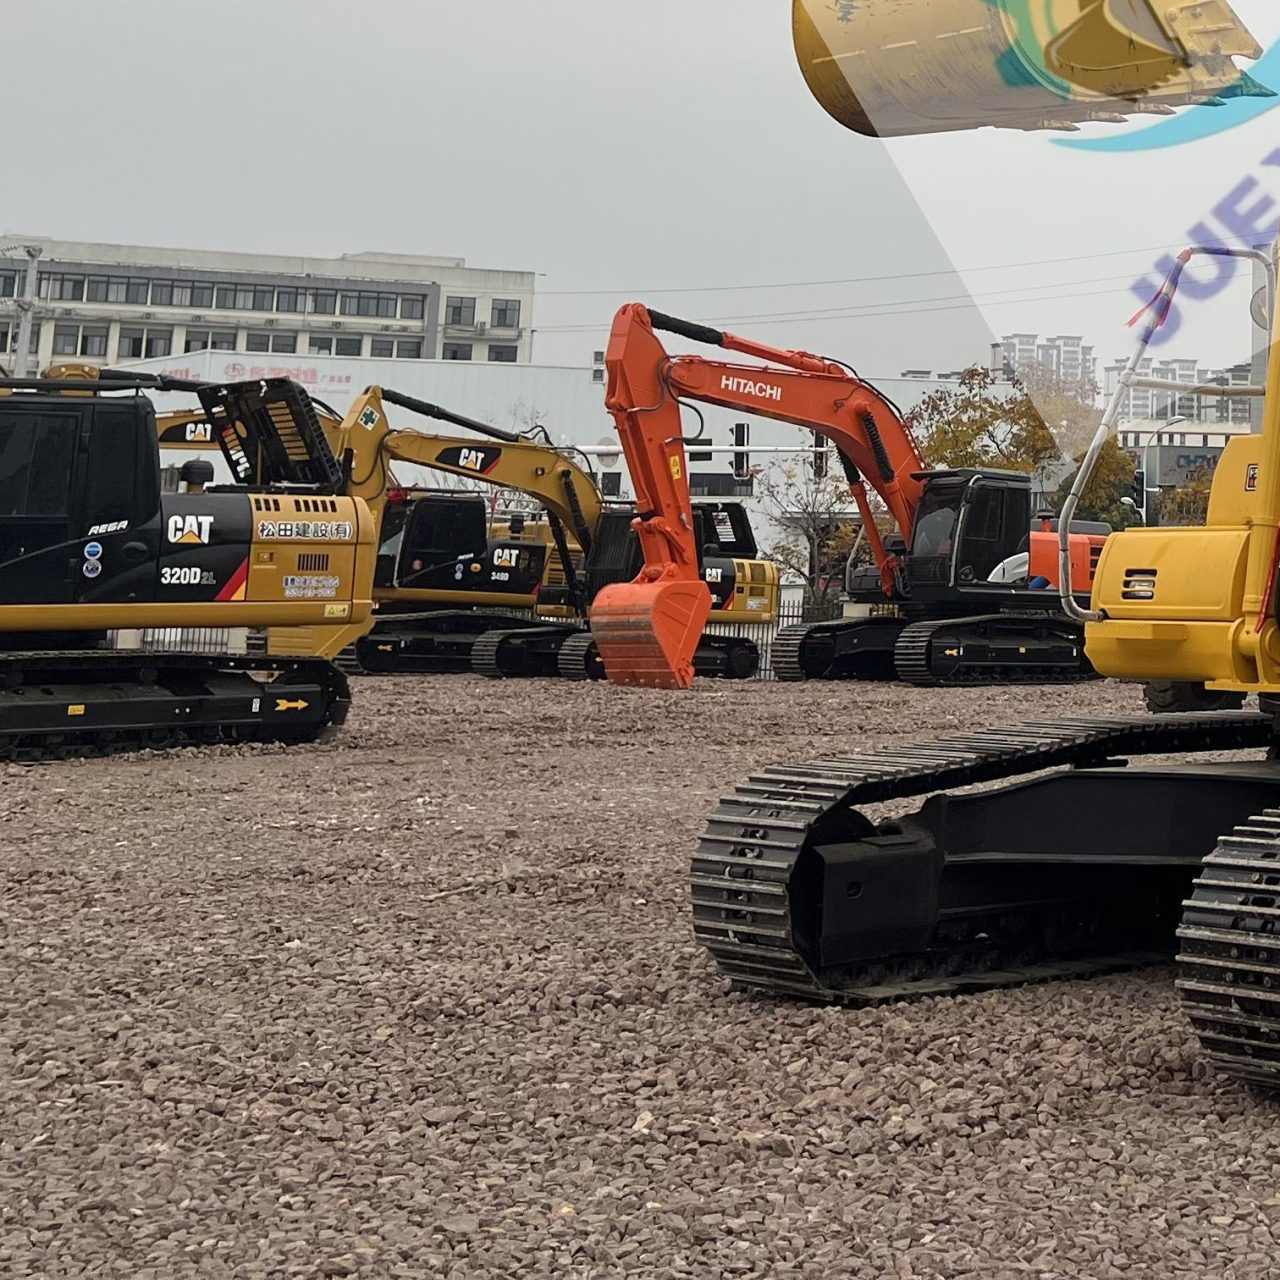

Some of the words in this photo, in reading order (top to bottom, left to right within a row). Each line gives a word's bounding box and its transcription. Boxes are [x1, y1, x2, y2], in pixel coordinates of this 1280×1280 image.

[720, 375, 782, 401] HITACHI
[185, 422, 212, 442] CAT
[458, 448, 485, 470] CAT
[167, 515, 215, 544] CAT
[493, 548, 519, 568] CAT
[705, 568, 723, 583] CAT
